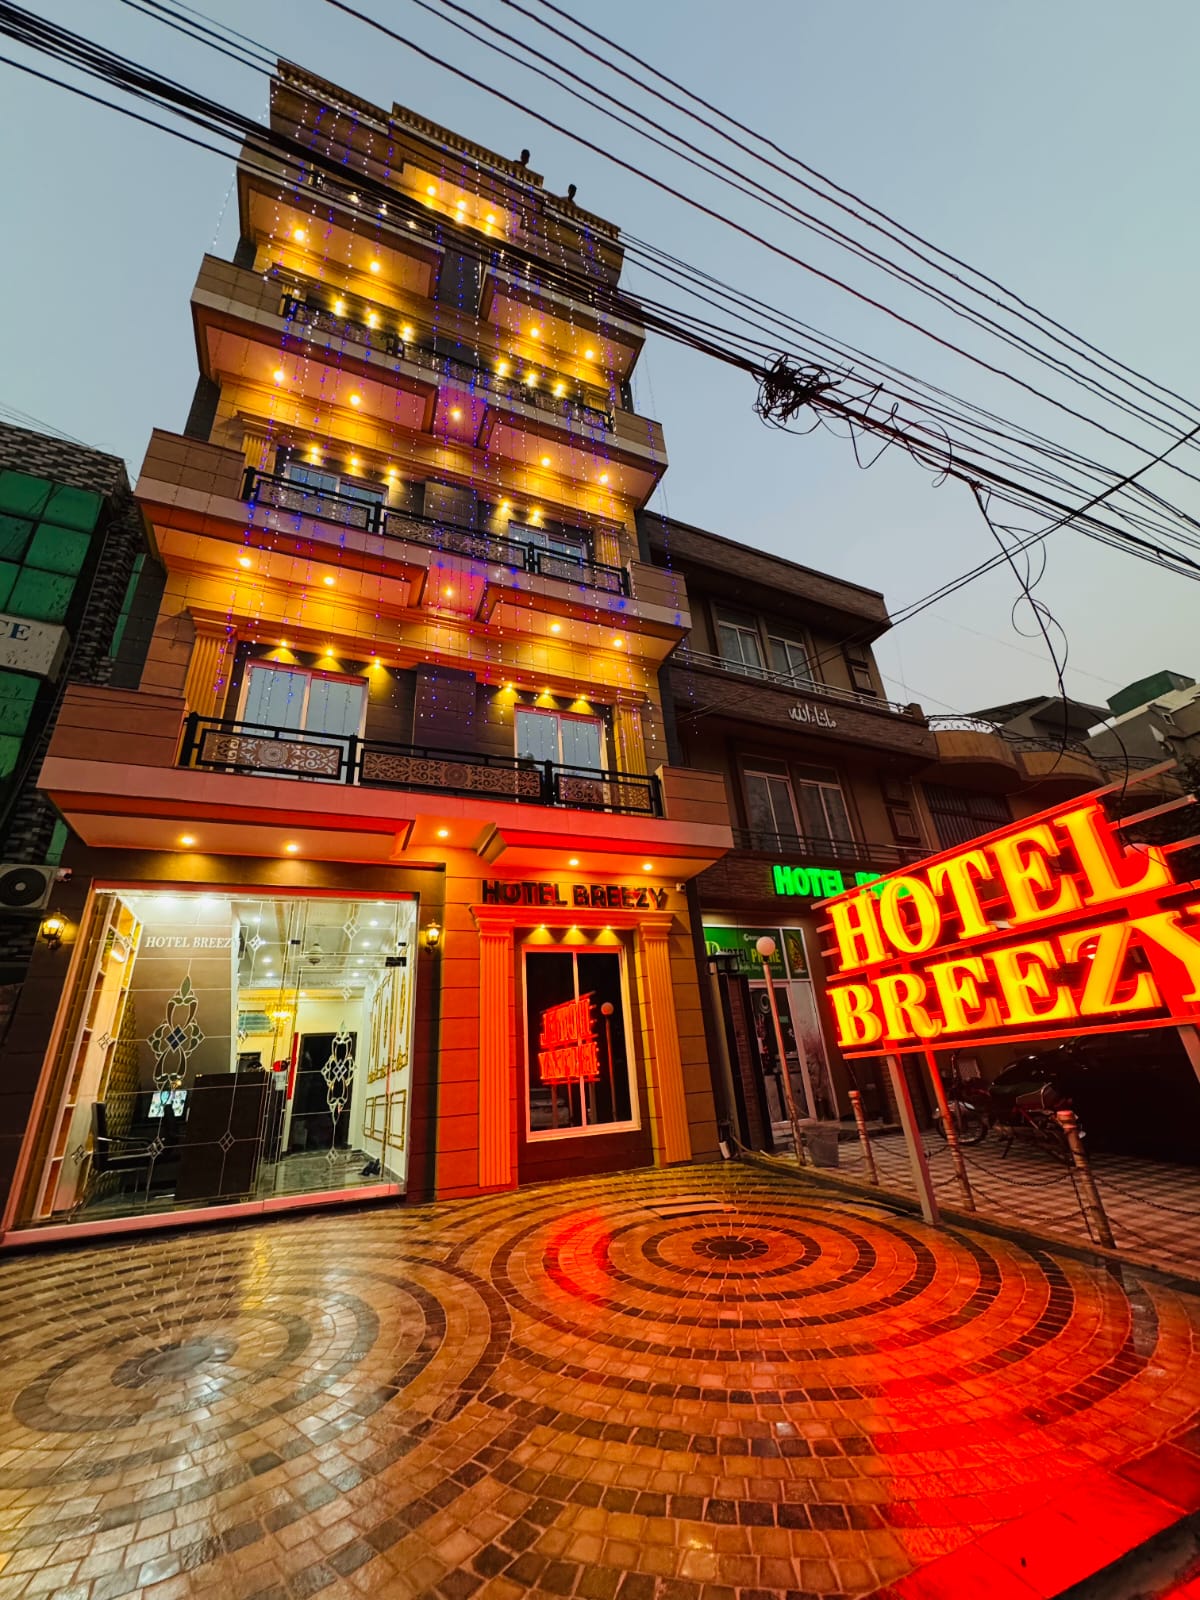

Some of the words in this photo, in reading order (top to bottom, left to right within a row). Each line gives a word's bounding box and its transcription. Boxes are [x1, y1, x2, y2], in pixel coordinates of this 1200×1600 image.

[482, 879, 568, 906] HOTEL
[572, 884, 668, 910] BREEZY
[773, 865, 845, 898] HOTEL
[825, 803, 1175, 972] HOTEL
[145, 937, 190, 948] HOTEL
[825, 903, 1200, 1047] BREEZY
